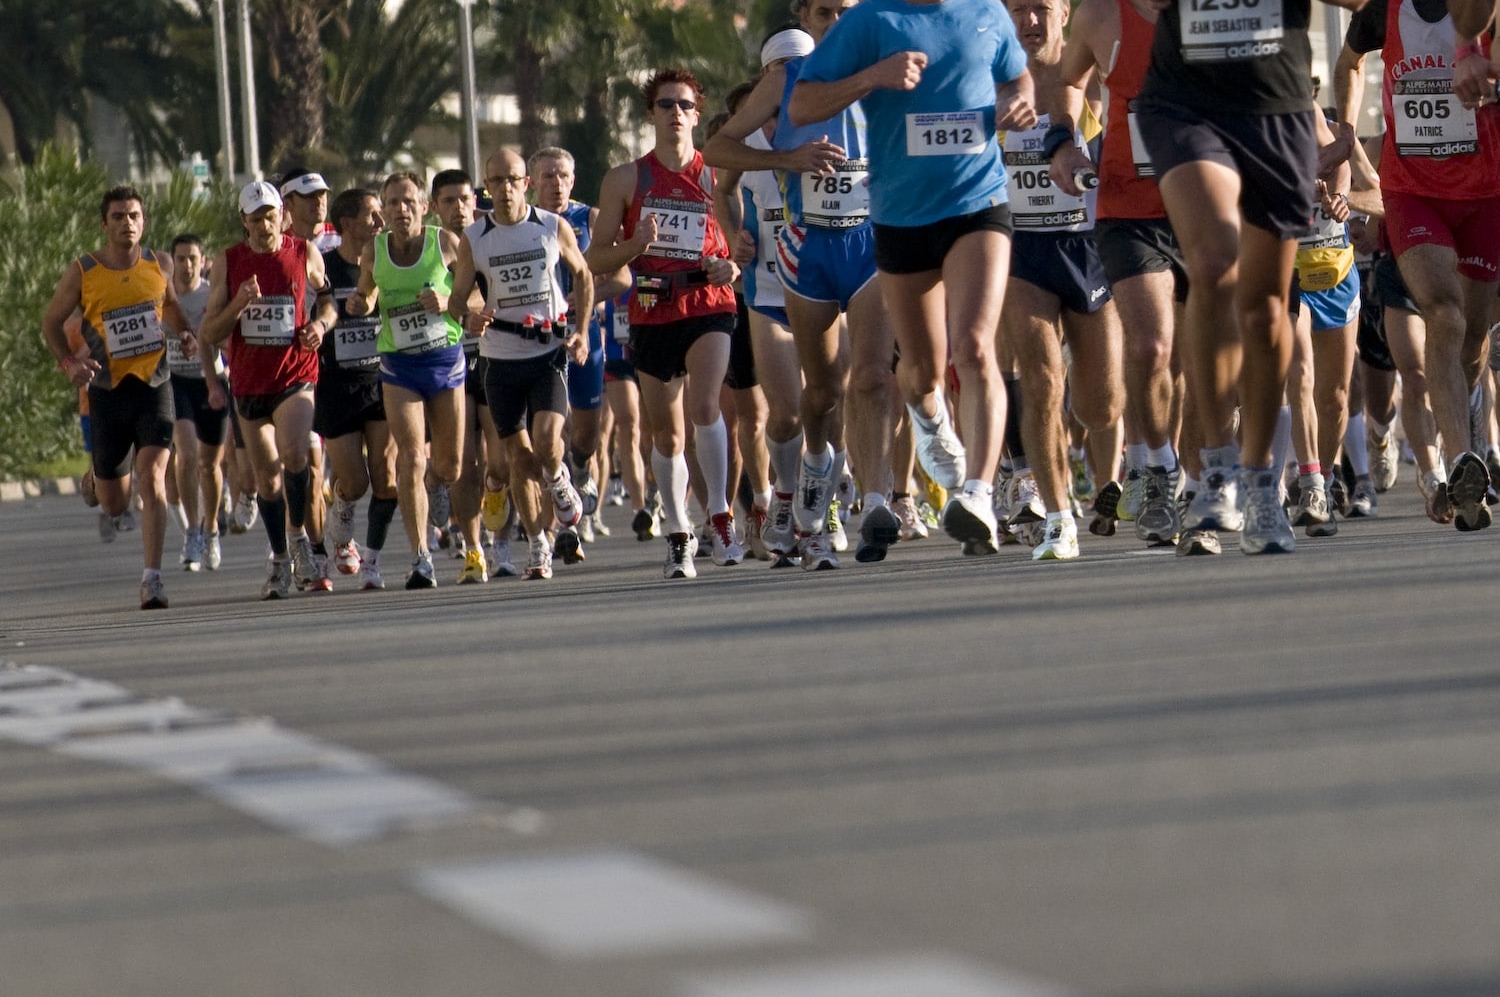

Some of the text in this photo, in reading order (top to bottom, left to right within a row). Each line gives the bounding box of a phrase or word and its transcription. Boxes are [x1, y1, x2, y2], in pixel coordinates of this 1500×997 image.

[1189, 16, 1262, 35] JEAN SEBASTIEN
[1228, 41, 1281, 59] adidas
[1392, 54, 1446, 80] CANAL
[1404, 99, 1450, 120] 605
[922, 127, 973, 146] 1812
[1414, 125, 1444, 137] PATRICE
[1432, 143, 1475, 156] adidas
[810, 174, 852, 194] 785
[821, 199, 841, 210] ALAIN
[1028, 195, 1055, 207] THIERRY
[658, 212, 689, 230] 741
[831, 217, 865, 228] adidas
[1043, 210, 1085, 224] adidas
[1314, 237, 1344, 250] adidas
[666, 249, 699, 261] adidas
[499, 265, 533, 283] 332
[521, 293, 549, 304] adidas
[244, 307, 285, 321] 1245
[109, 315, 148, 335] 1281
[399, 313, 429, 332] 915
[265, 336, 292, 346] adidas
[338, 328, 376, 344] 1333
